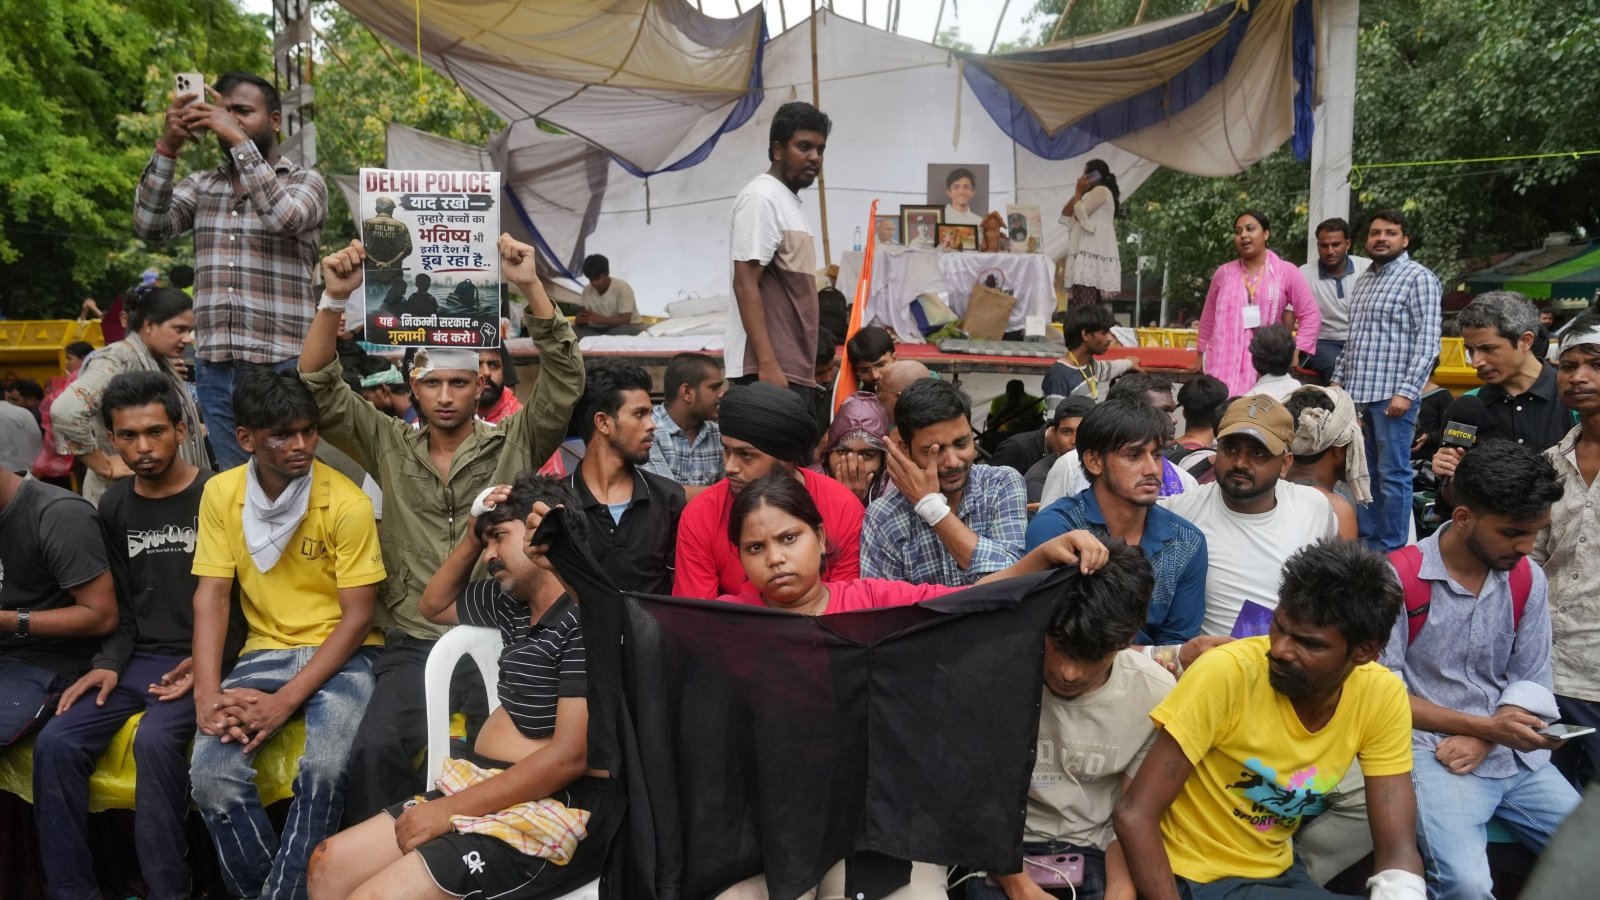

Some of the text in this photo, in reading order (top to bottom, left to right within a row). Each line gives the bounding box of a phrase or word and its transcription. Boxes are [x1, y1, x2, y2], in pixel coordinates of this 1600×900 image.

[365, 172, 491, 194] DELHI POLICE
[409, 196, 438, 209] याद
[417, 212, 486, 226] तुम्हारे बच्चों का
[373, 231, 396, 239] POLICE
[374, 224, 395, 232] DELHI
[418, 224, 484, 244] भविष्य भी
[419, 244, 471, 254] इसी देश में
[420, 255, 443, 271] डूब
[445, 255, 470, 267] रहा
[378, 316, 394, 328] यह
[400, 313, 438, 328] निकम्मी
[438, 316, 472, 329] सरकार
[387, 327, 427, 346] गुलामी
[432, 330, 449, 343] बंद
